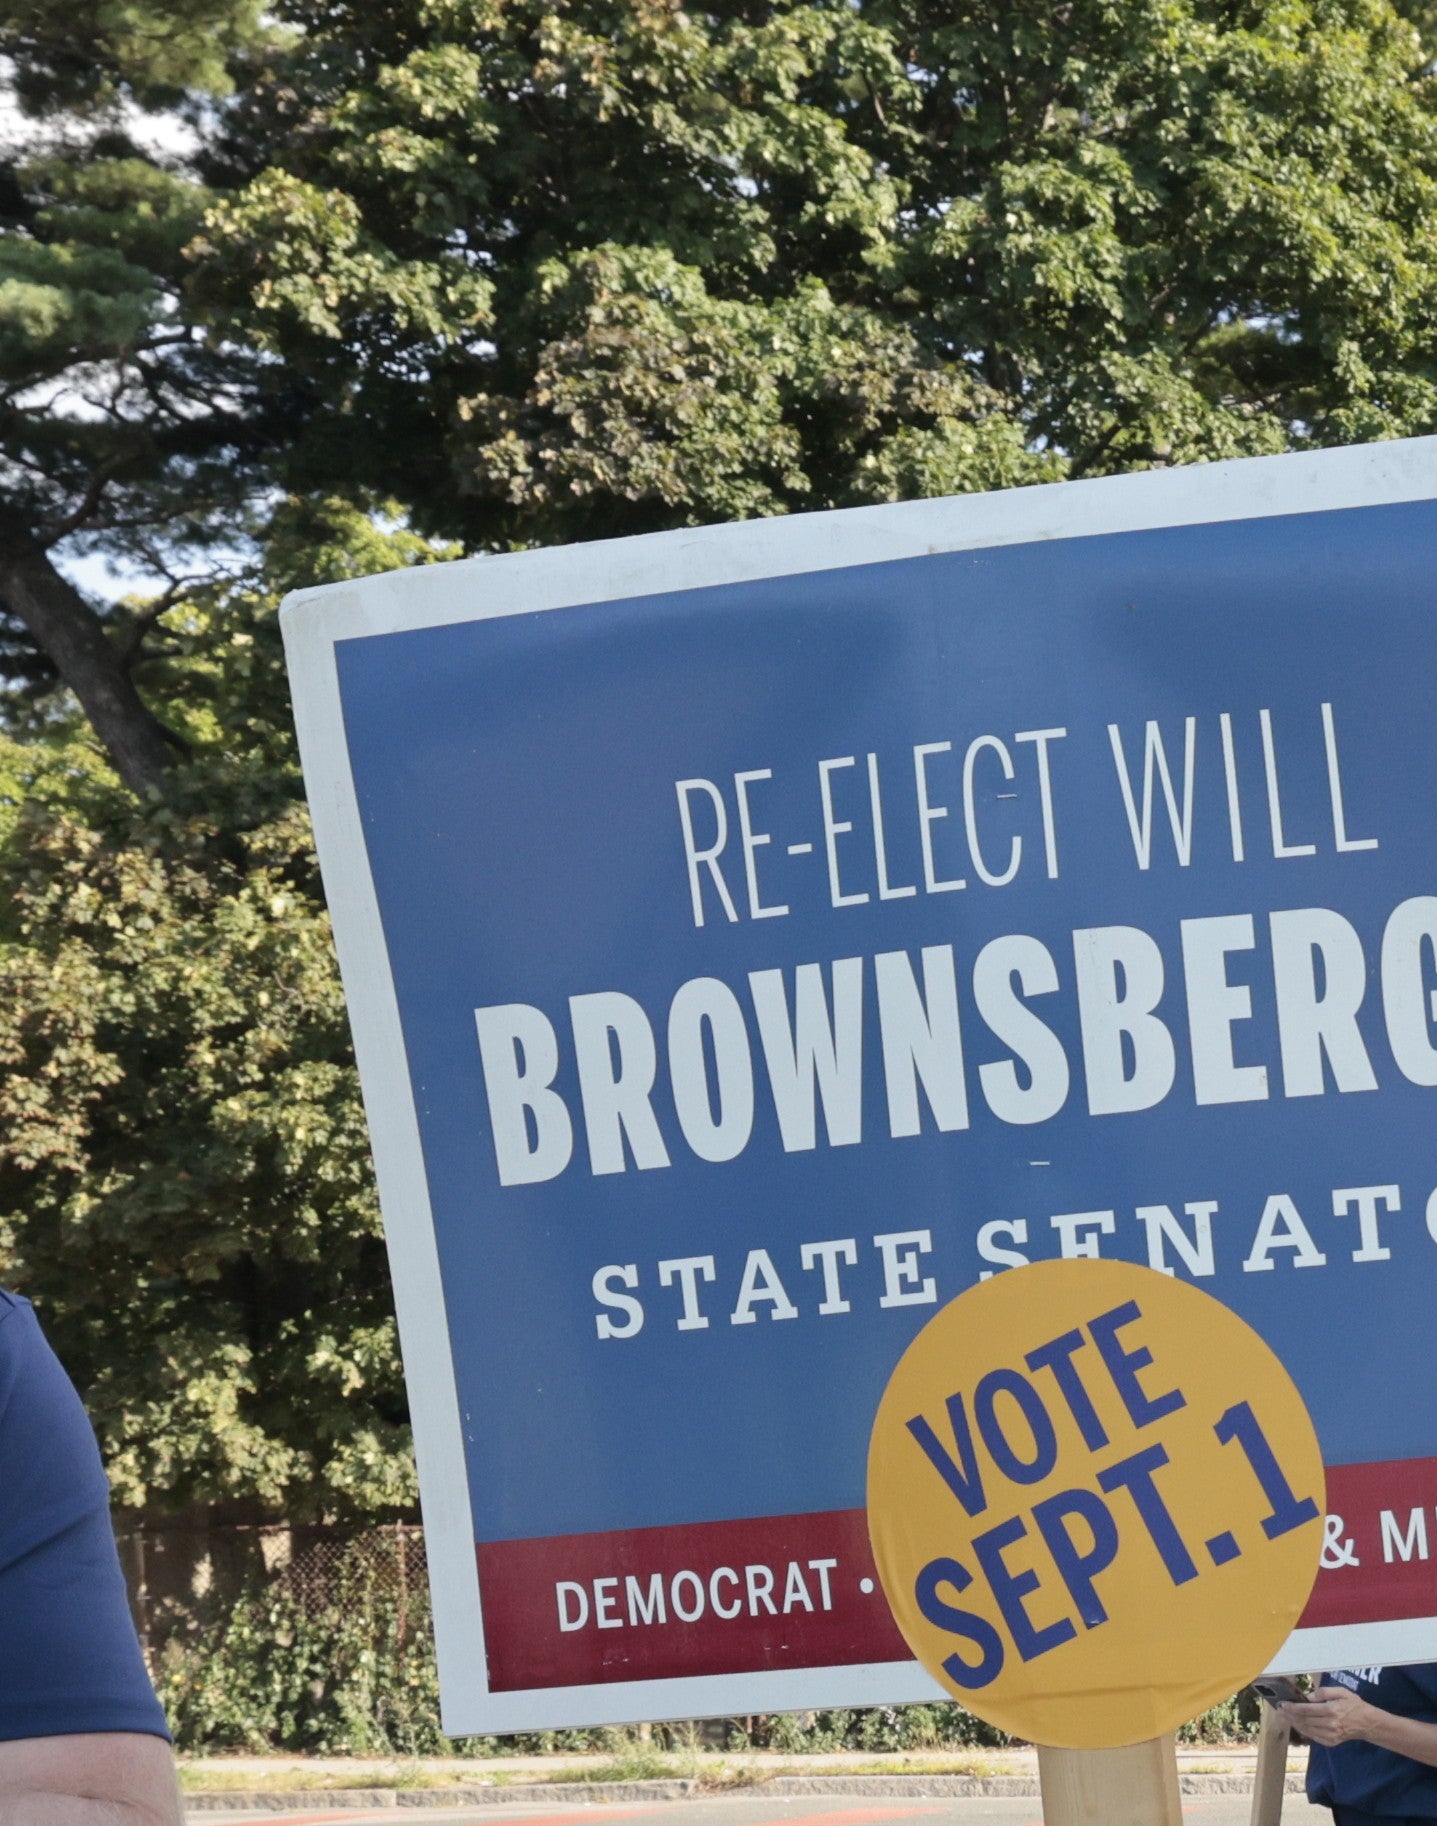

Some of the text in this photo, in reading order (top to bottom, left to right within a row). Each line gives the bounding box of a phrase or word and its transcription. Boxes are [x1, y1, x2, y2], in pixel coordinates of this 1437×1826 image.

[675, 702, 1378, 926] RE-ELECT WILL
[593, 1229, 936, 1340] STATE
[905, 1299, 1187, 1517] VOTE
[556, 1557, 838, 1633] DEMOCRAT
[1320, 1512, 1359, 1569] &
